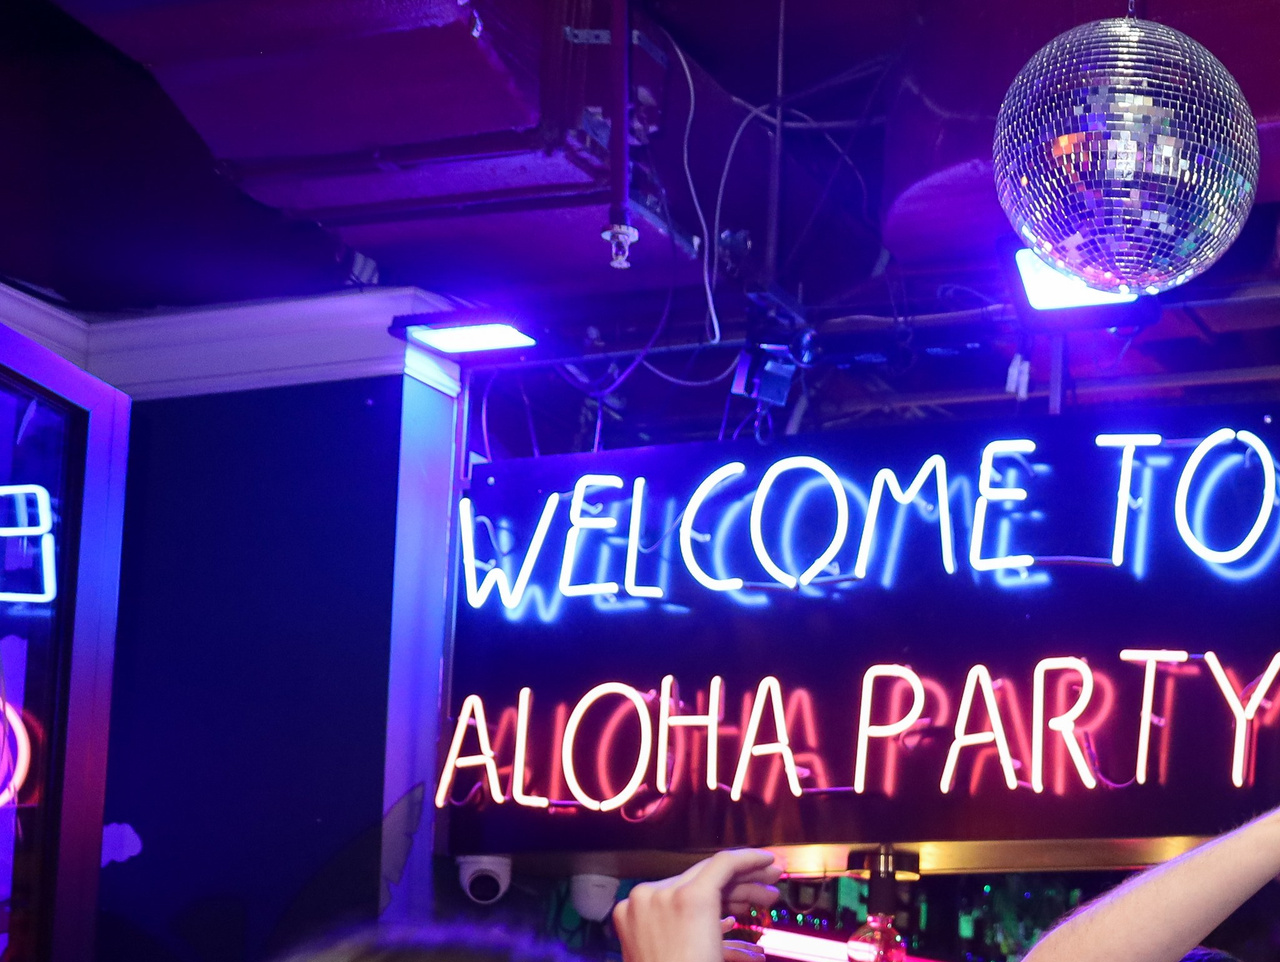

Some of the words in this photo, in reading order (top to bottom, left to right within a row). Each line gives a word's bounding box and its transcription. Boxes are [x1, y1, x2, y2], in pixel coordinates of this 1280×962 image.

[458, 438, 1036, 610] WELCOME
[1093, 426, 1278, 567] TO
[435, 673, 803, 811] ALOHA
